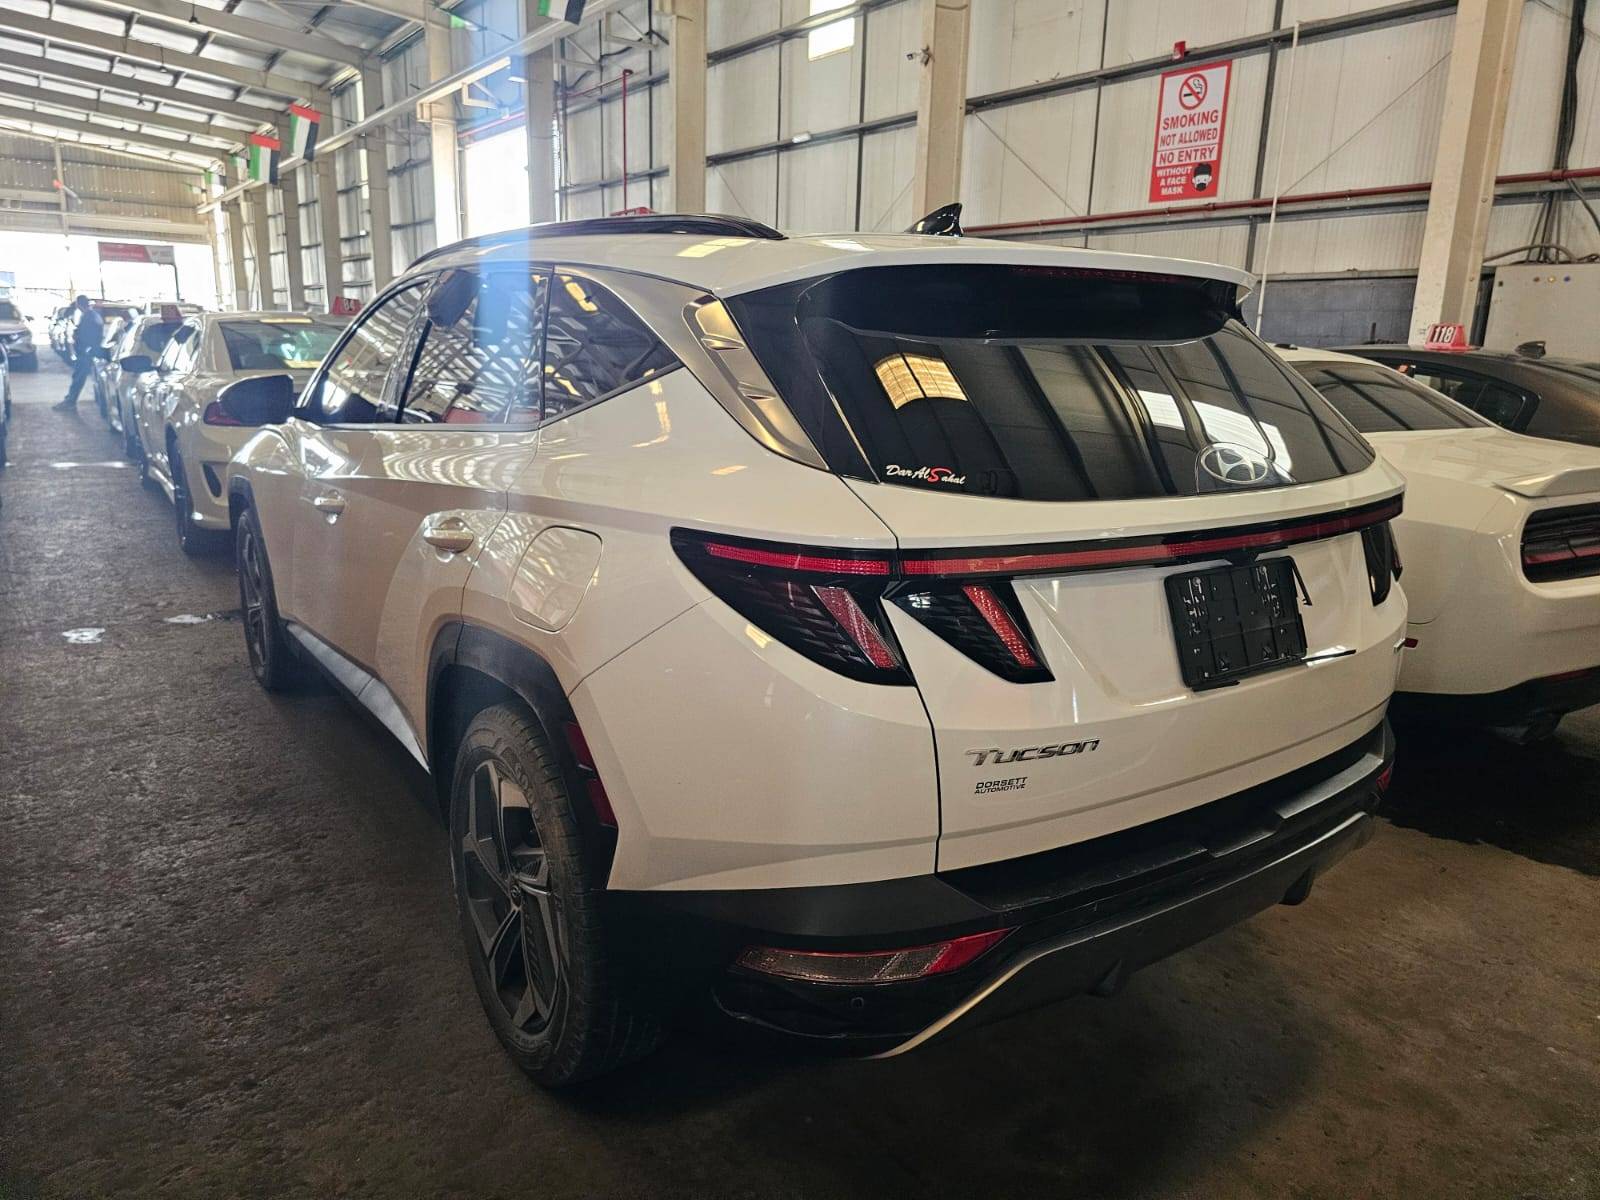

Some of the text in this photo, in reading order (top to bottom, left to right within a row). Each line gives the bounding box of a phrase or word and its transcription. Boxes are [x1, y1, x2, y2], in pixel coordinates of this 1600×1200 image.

[1162, 109, 1219, 131] SMOKING
[1160, 127, 1218, 147] NOT ALLOWED
[1159, 146, 1215, 165] NO ENTRY
[1156, 166, 1192, 177] WITHOUT
[1160, 175, 1187, 186] A FACE
[1161, 185, 1184, 196] MASK
[1432, 326, 1455, 343] 118
[975, 777, 1028, 789] DORSETT
[974, 784, 1027, 795] AUTOMOTIVE
